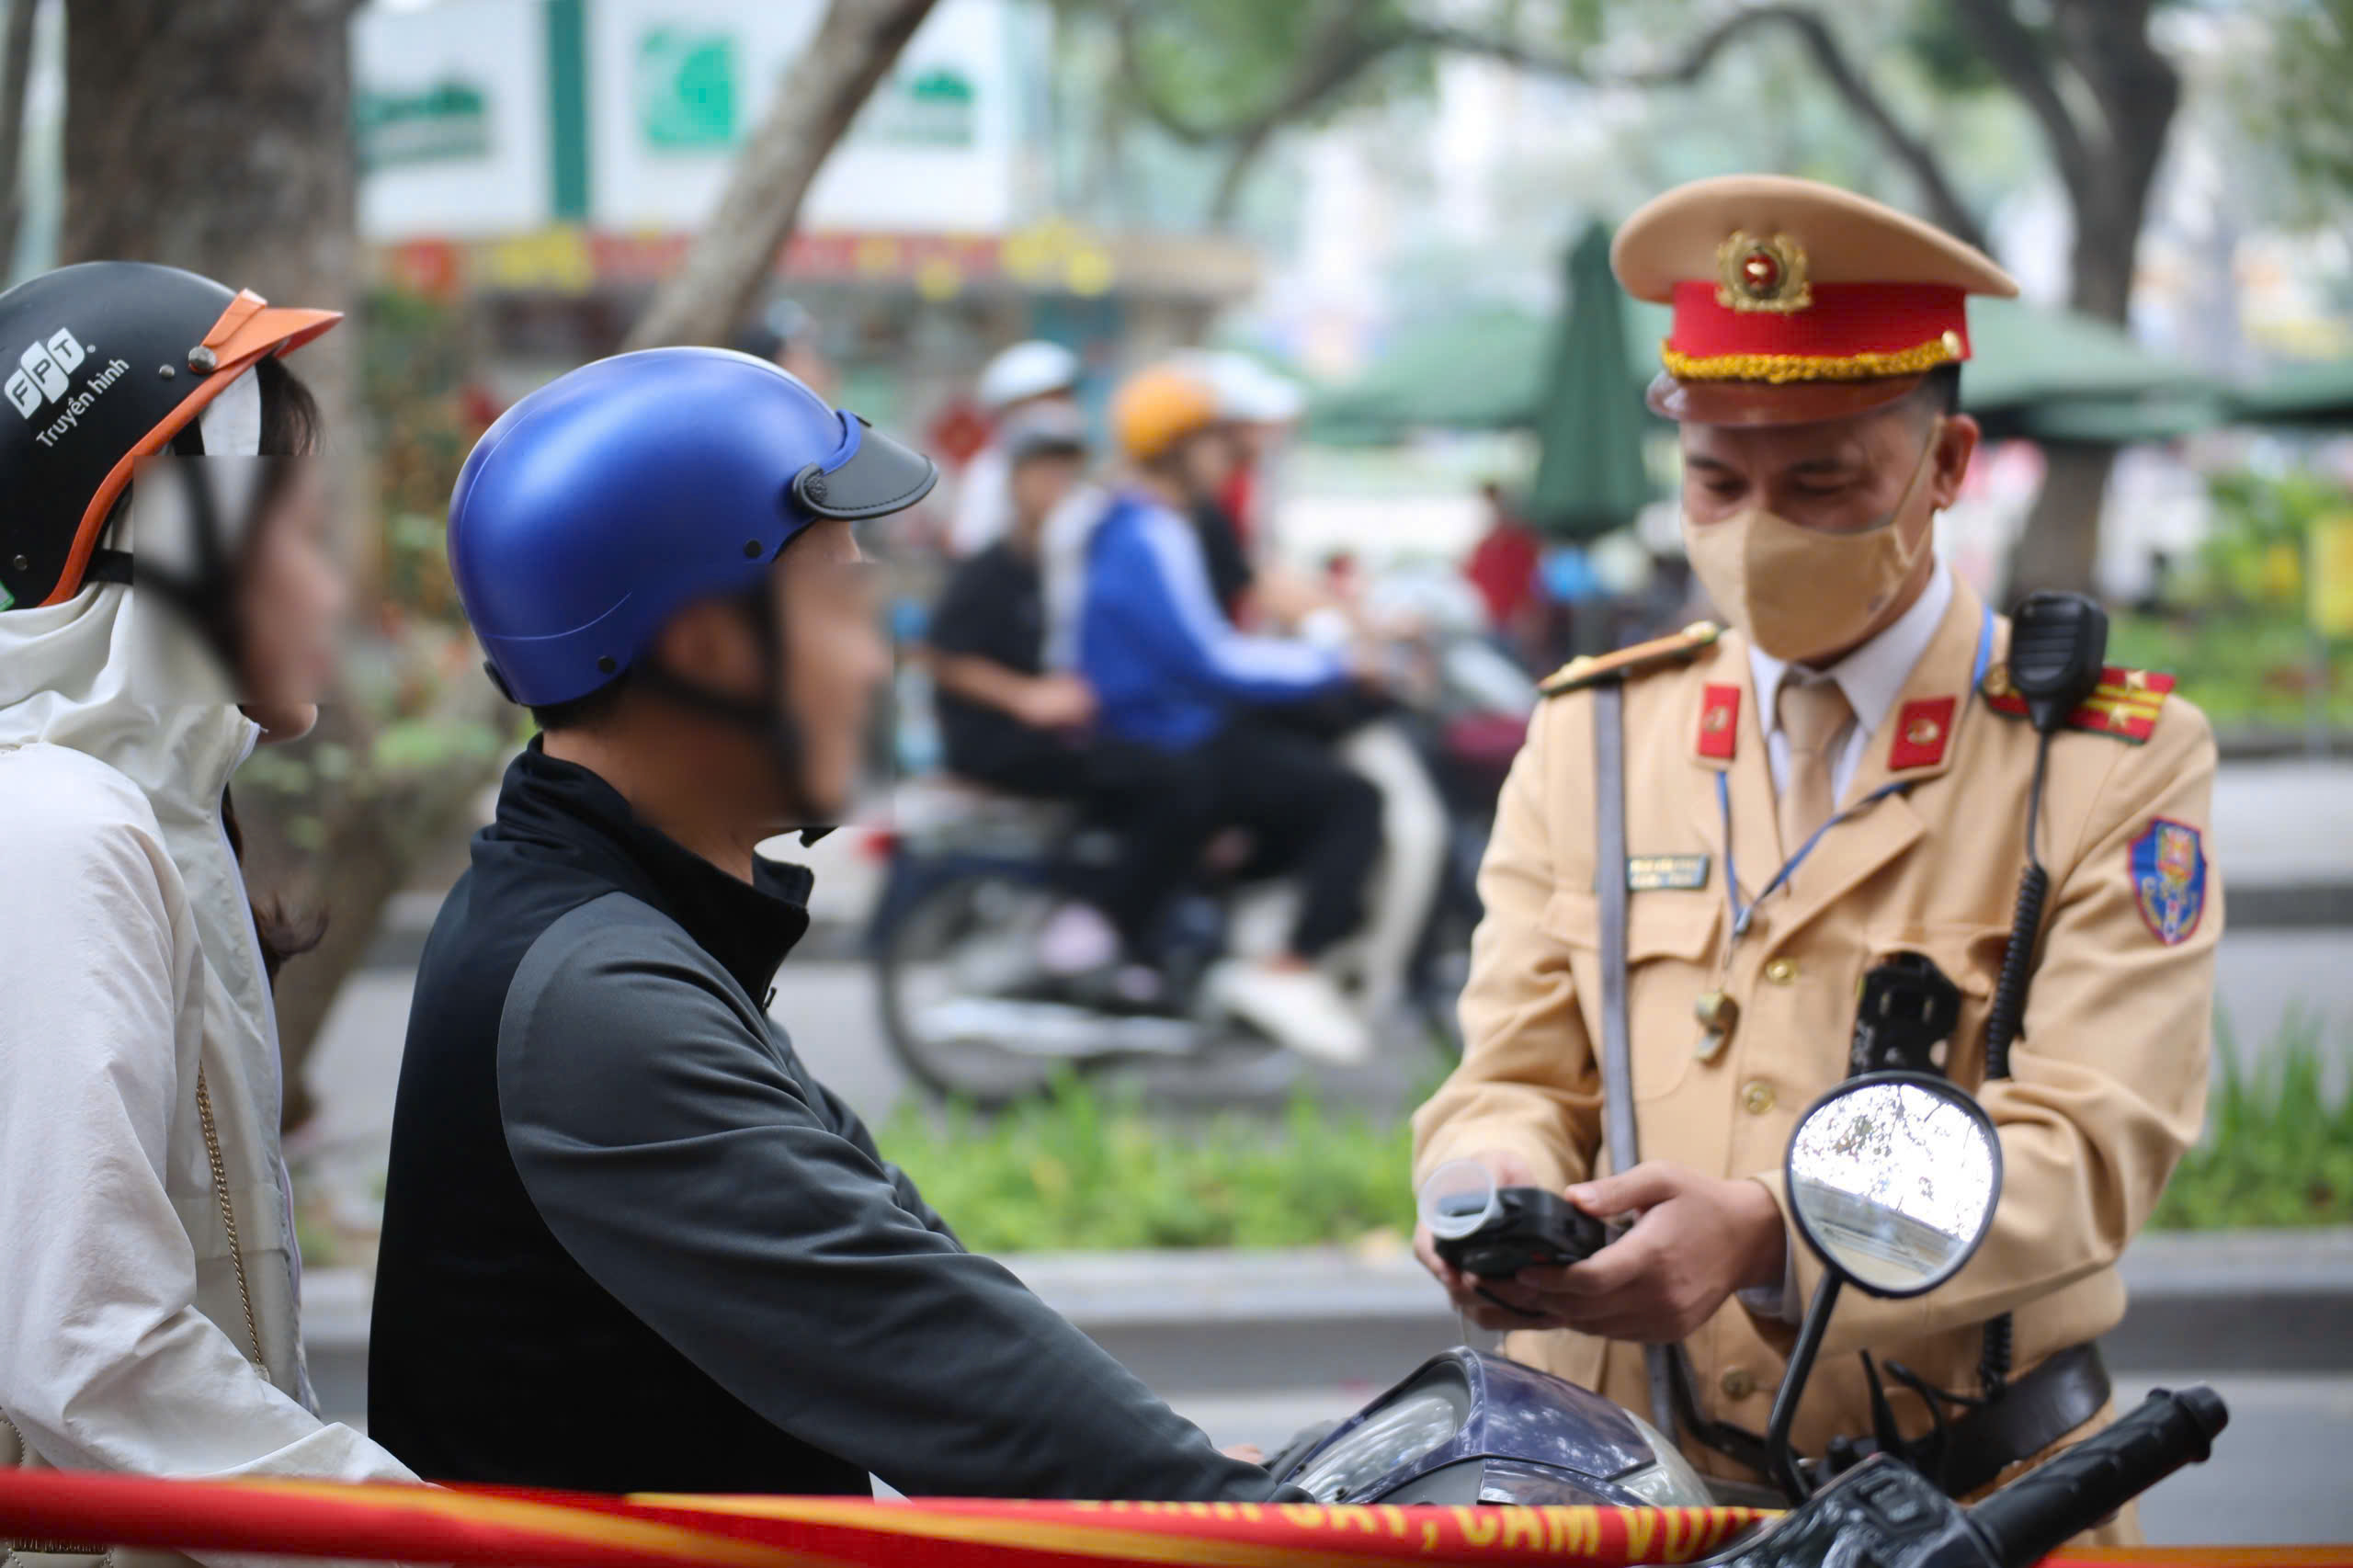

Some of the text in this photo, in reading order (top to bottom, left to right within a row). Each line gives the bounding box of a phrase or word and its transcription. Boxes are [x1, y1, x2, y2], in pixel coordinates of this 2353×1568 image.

[6, 329, 85, 418] FPT
[36, 358, 131, 448] Truyền hình
